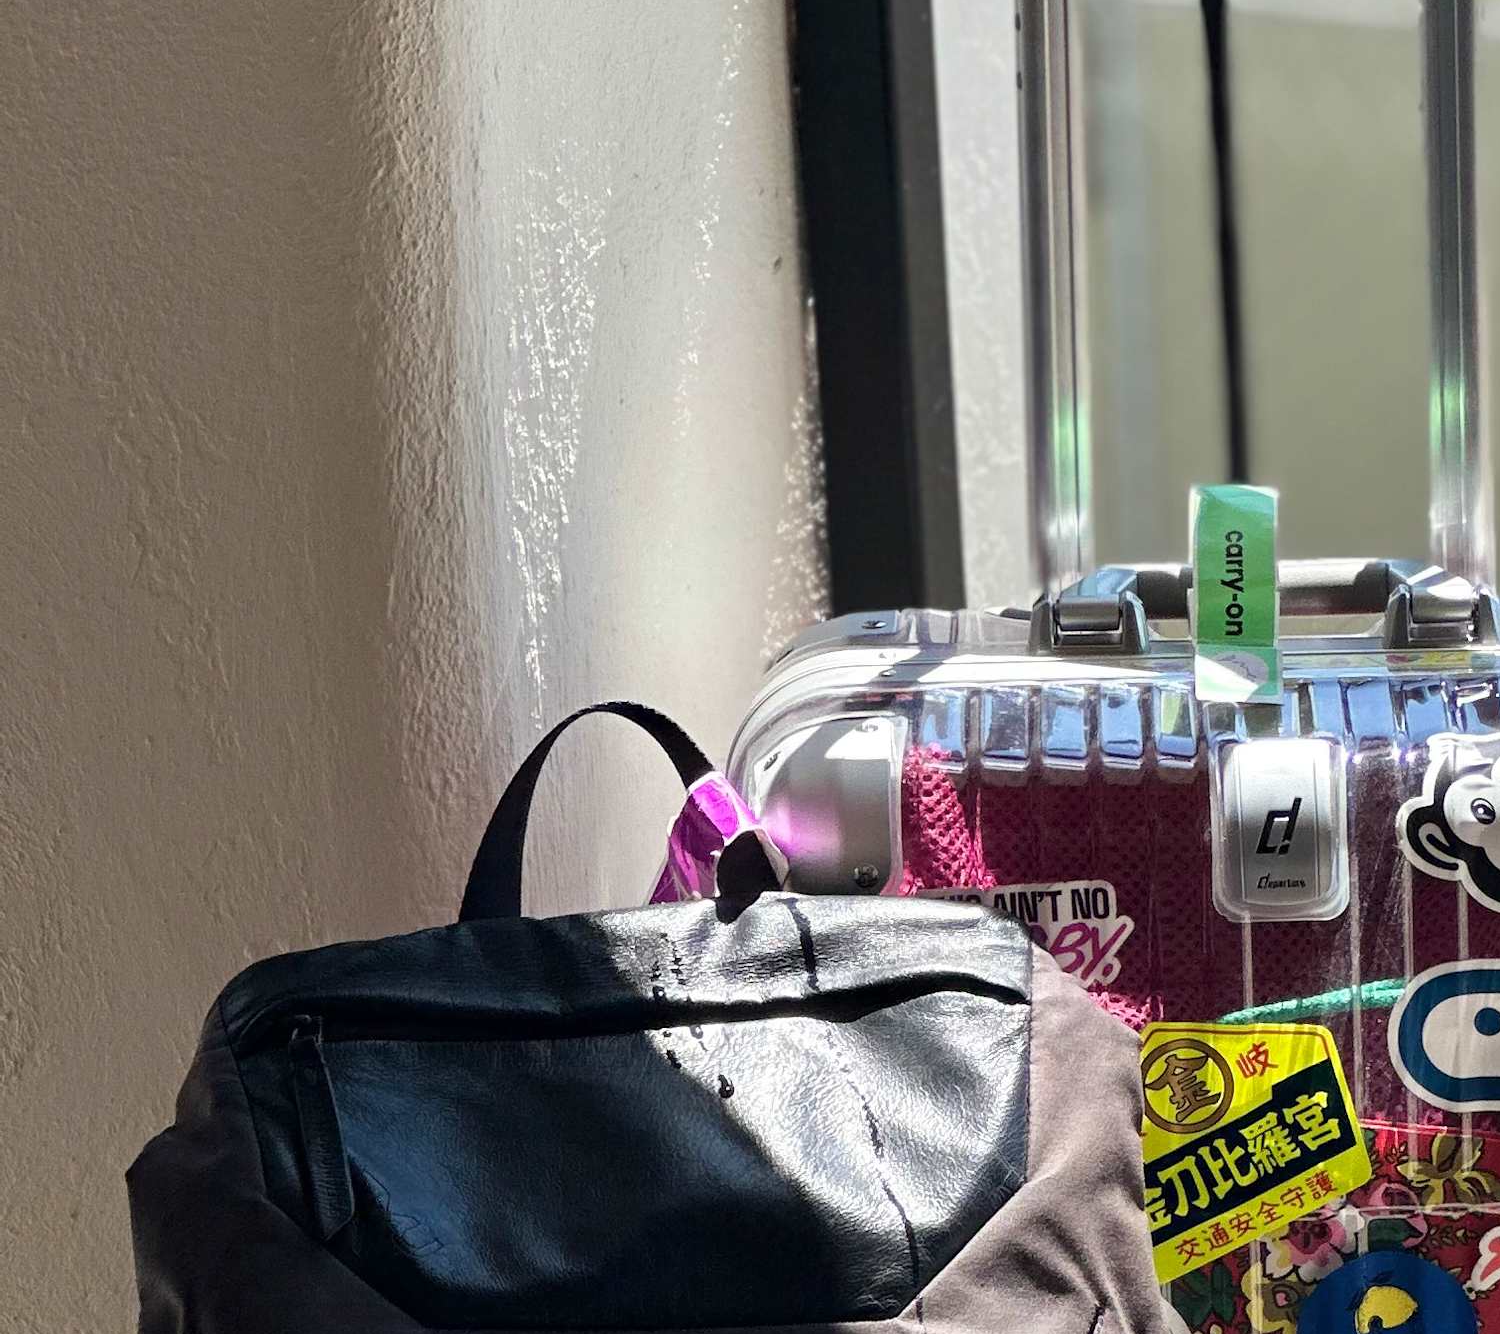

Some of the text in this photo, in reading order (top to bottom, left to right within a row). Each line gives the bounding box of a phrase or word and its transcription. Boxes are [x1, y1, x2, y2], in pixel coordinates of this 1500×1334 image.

[1221, 530, 1244, 636] carry-on
[1071, 887, 1109, 919] NO
[1175, 1170, 1338, 1266] 交通安全守護
